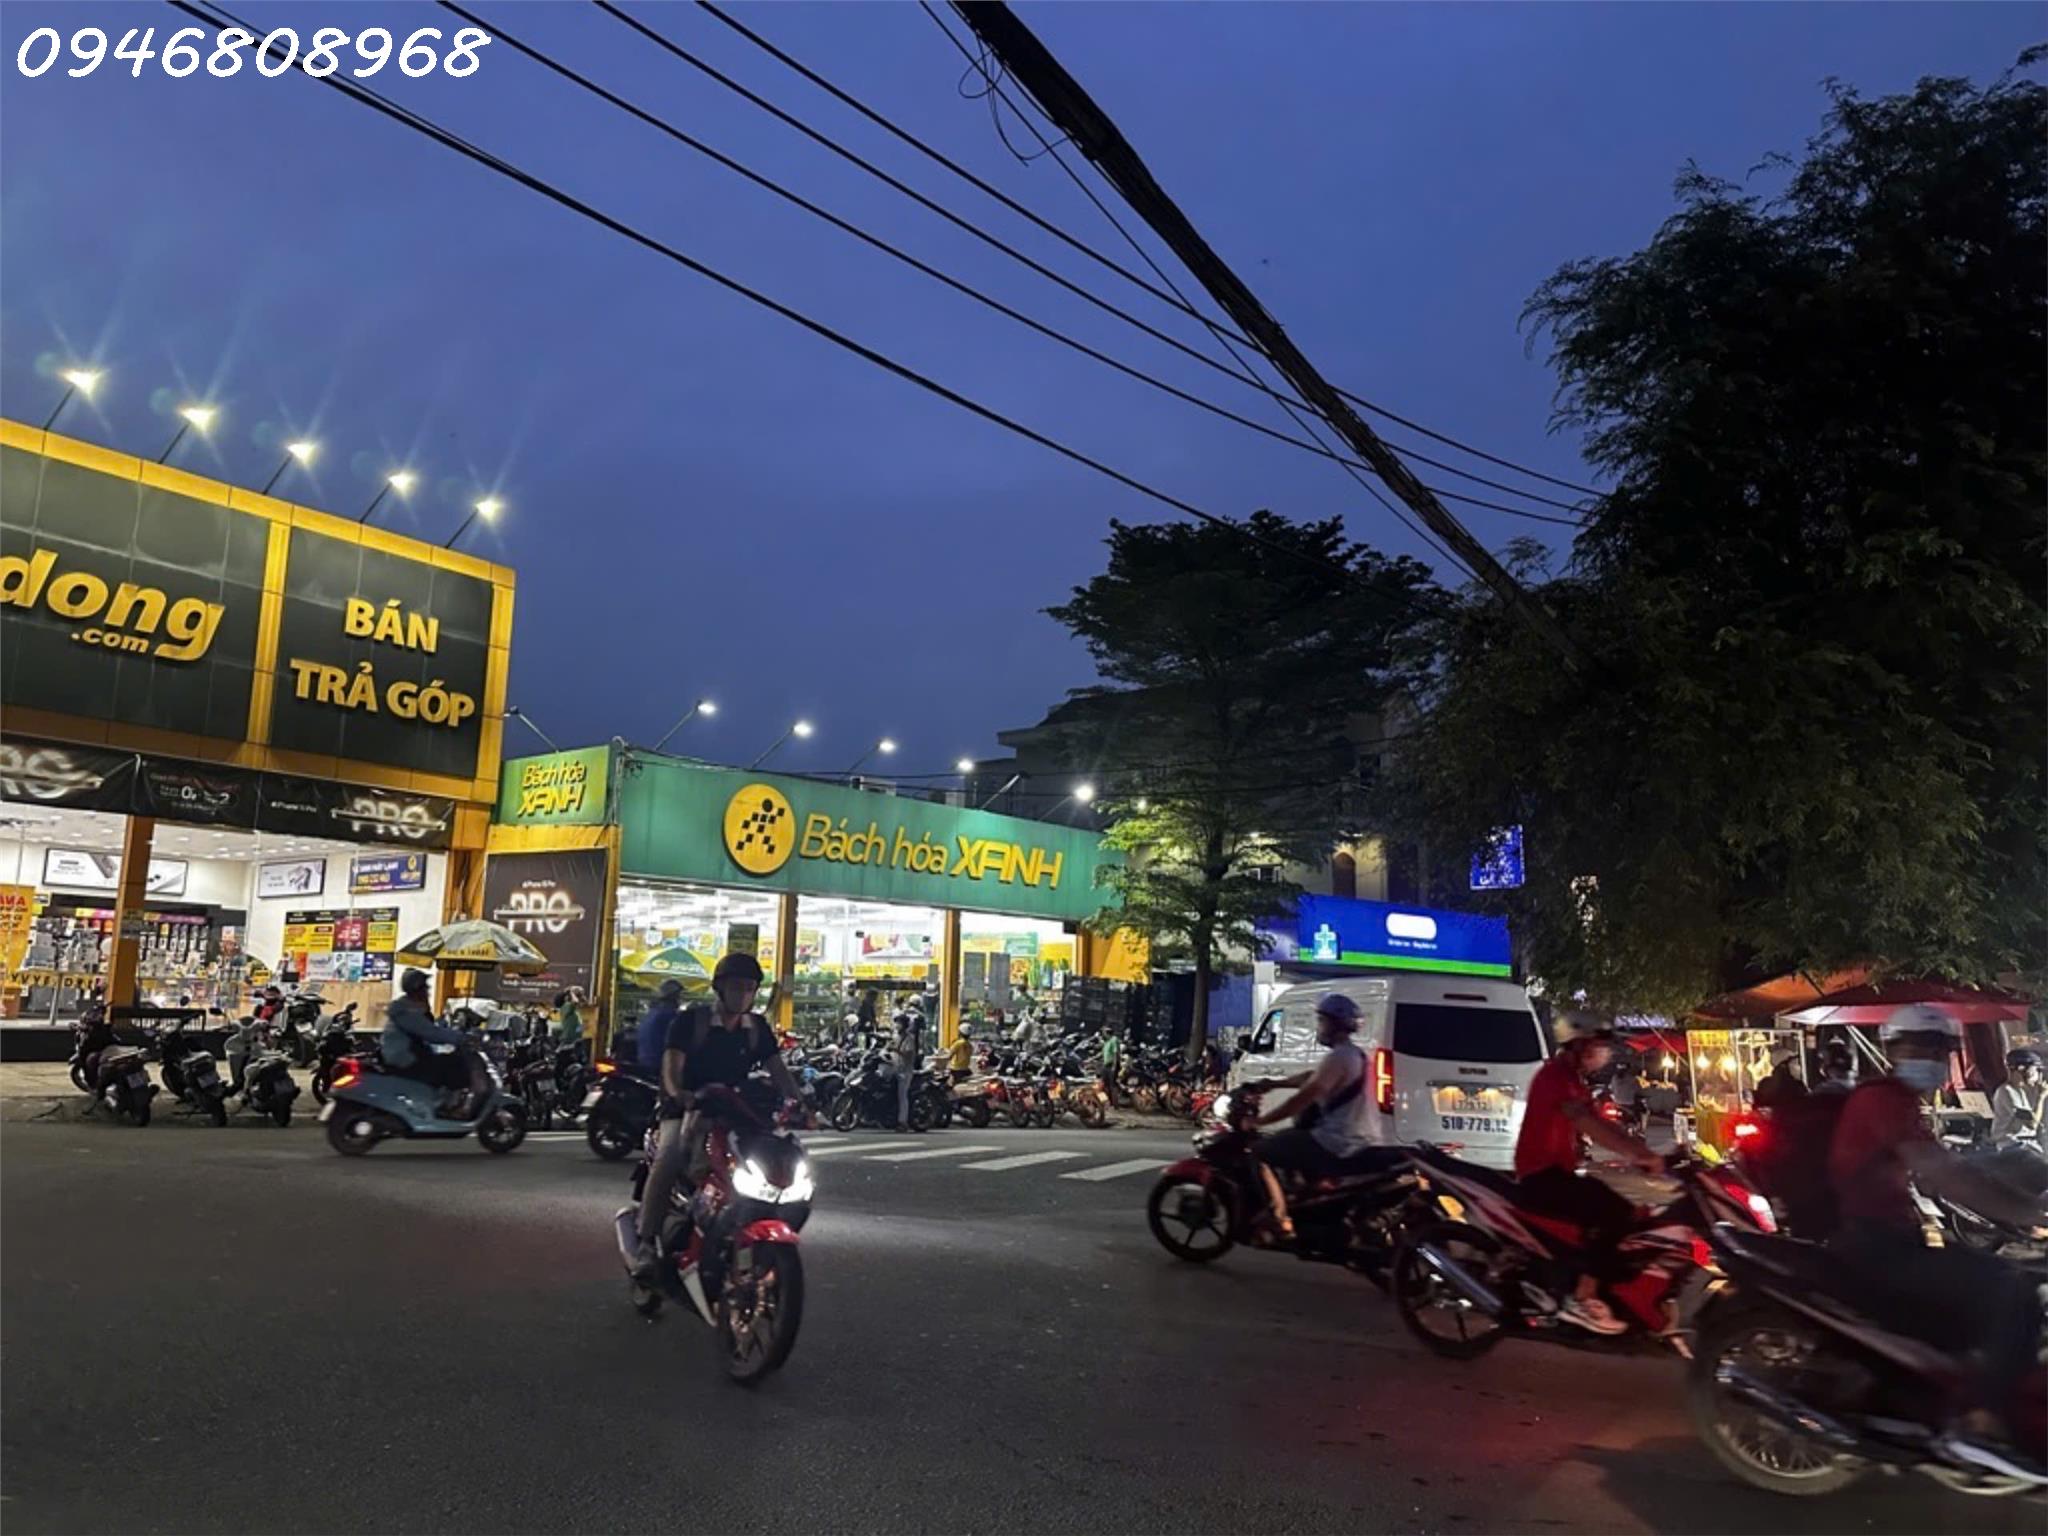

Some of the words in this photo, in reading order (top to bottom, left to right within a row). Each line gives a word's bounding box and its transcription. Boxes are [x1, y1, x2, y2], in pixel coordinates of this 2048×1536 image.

[0, 548, 226, 661] dong
[344, 597, 440, 654] BÁN
[71, 627, 150, 653] .com
[289, 657, 379, 713] TRẢ
[522, 763, 559, 788] Bách
[560, 760, 586, 784] hóa
[352, 797, 430, 839] PRO
[517, 783, 587, 818] XANH
[800, 813, 886, 866] Bách
[891, 825, 949, 874] hóa
[949, 833, 1064, 889] XANH
[510, 890, 571, 934] PRO
